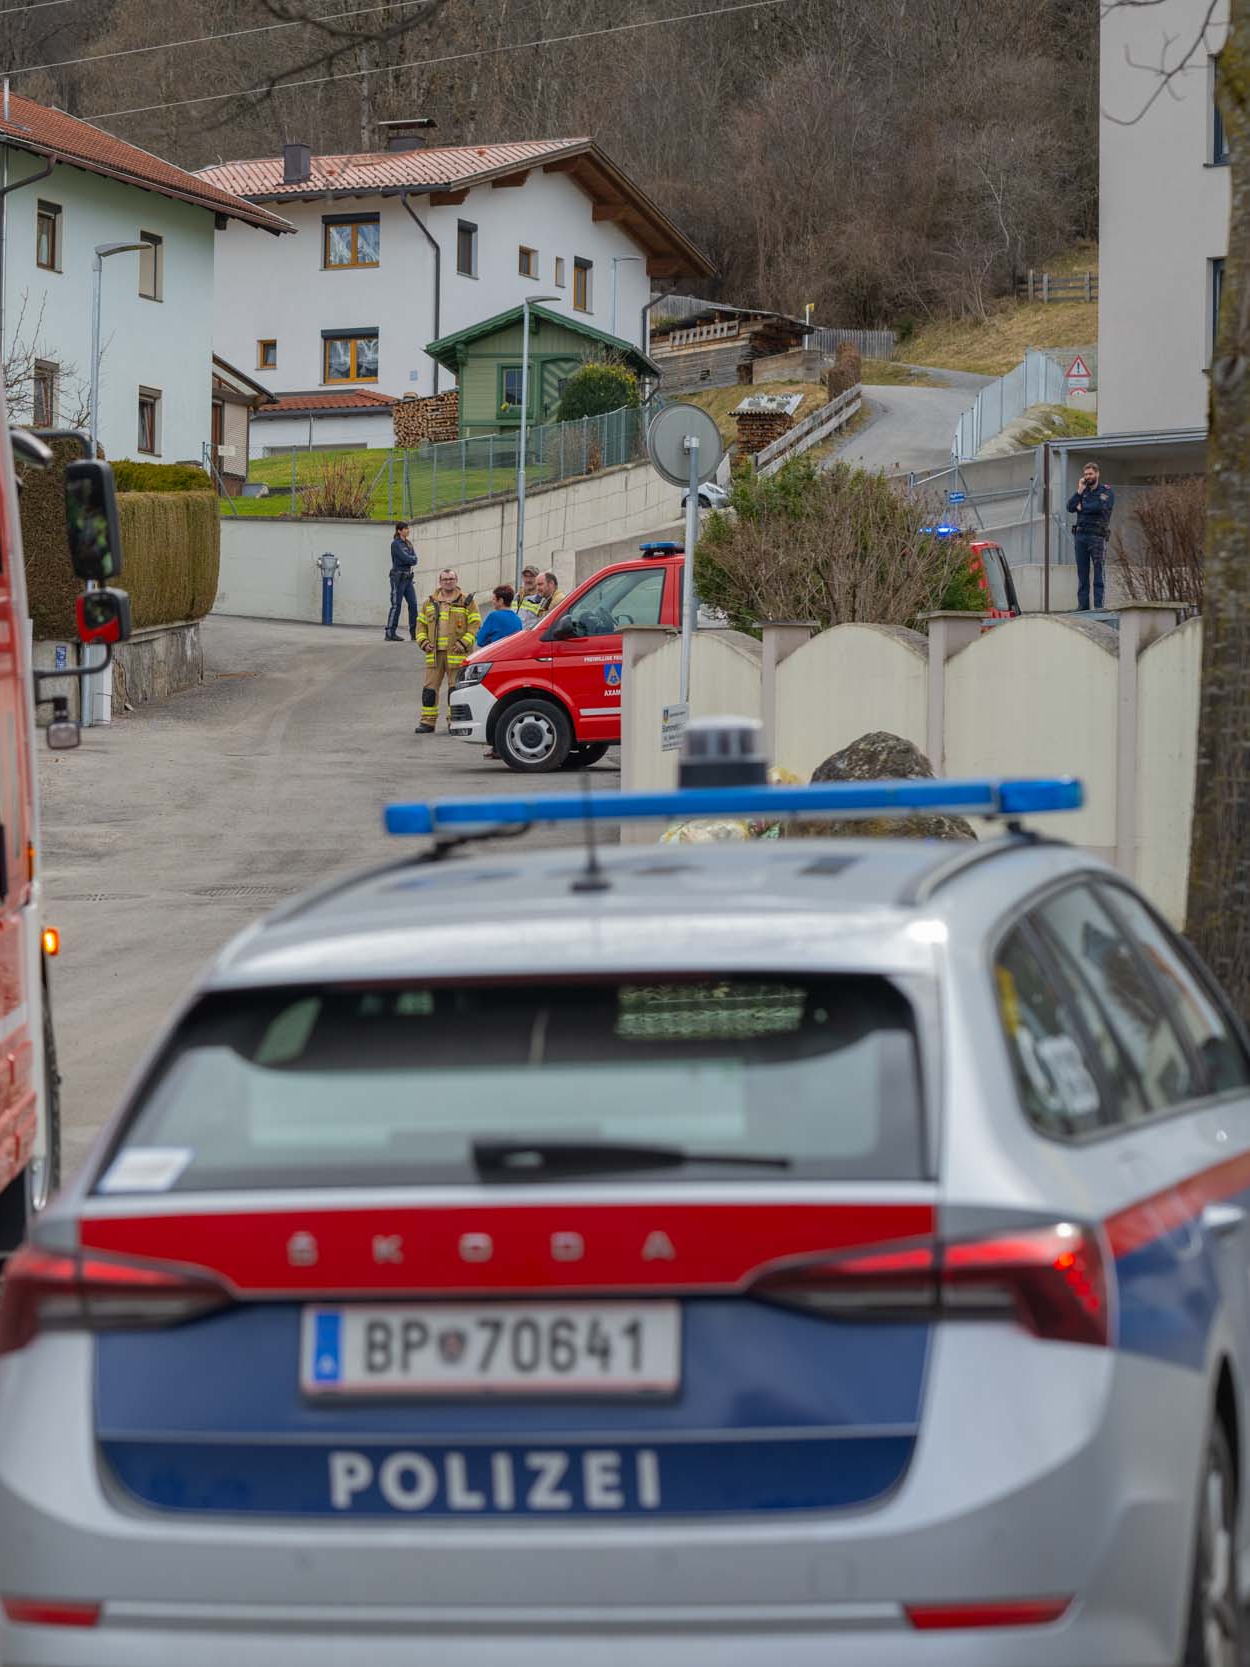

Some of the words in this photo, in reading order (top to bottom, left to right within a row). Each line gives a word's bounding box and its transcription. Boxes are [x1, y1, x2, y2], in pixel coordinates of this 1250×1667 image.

[363, 1317, 431, 1376] BP
[475, 1316, 645, 1375] 70641
[328, 1449, 662, 1512] POLIZEI
